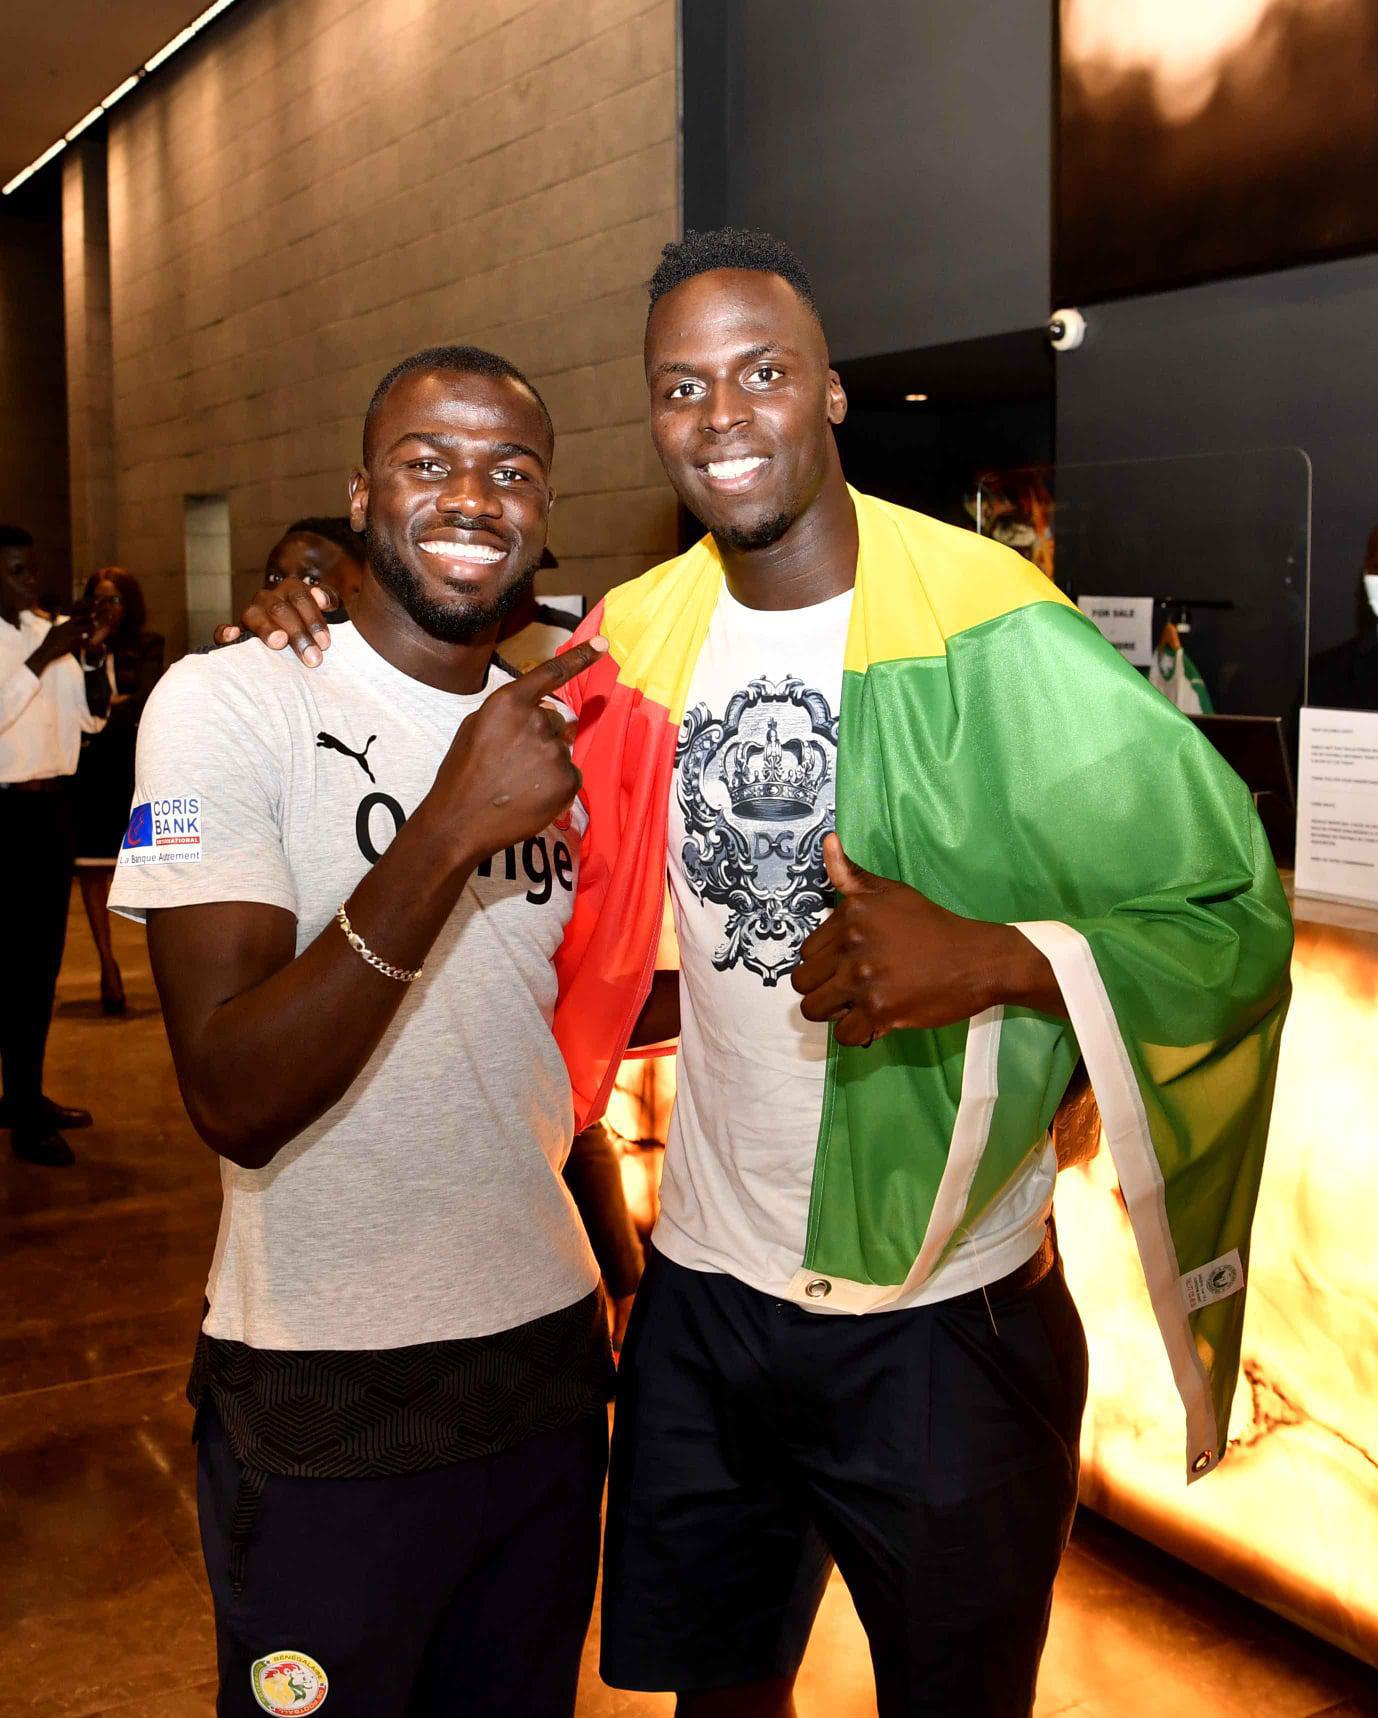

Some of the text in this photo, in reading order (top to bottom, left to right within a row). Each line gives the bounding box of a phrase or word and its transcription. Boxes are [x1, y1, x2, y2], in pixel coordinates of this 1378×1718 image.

[153, 798, 199, 816] CORIS
[154, 817, 199, 835] BANK
[131, 854, 157, 864] Banque
